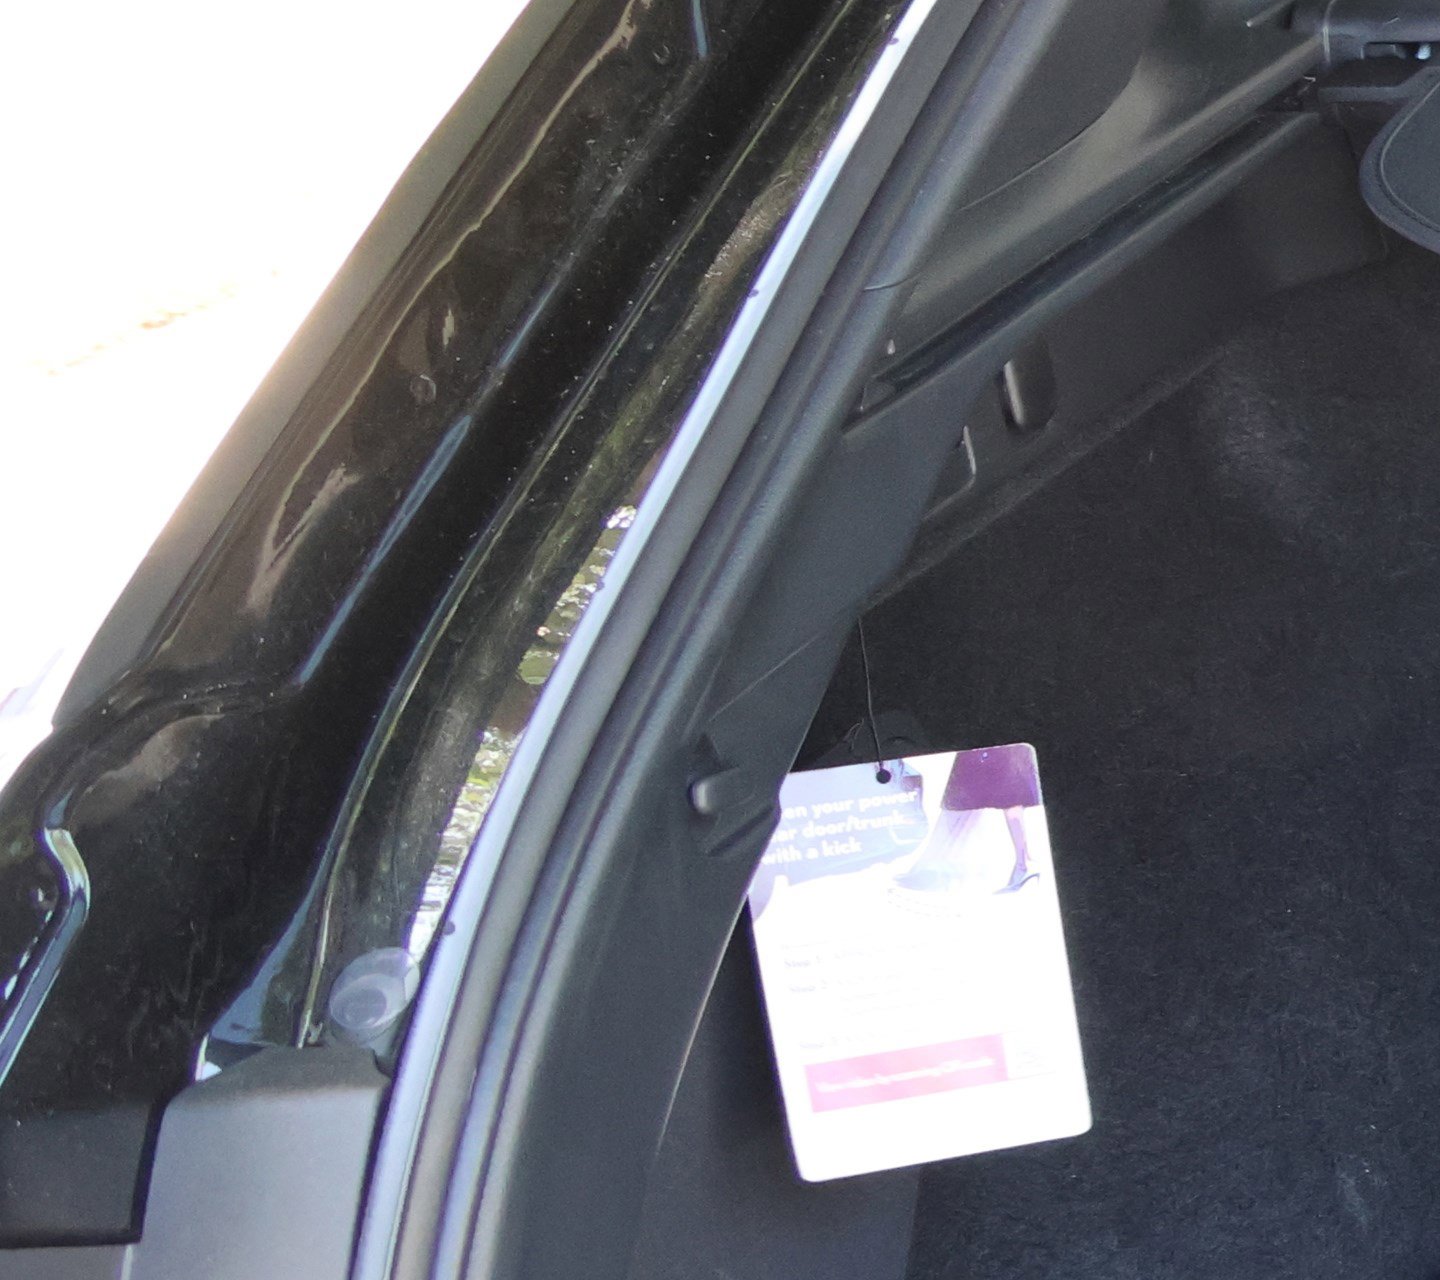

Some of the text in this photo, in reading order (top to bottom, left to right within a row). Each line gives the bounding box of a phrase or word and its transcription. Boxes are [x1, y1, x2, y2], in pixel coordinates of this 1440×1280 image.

[783, 790, 917, 820] en your power
[802, 809, 905, 838] door/trunk
[806, 847, 819, 860] a
[821, 836, 863, 858] kick
